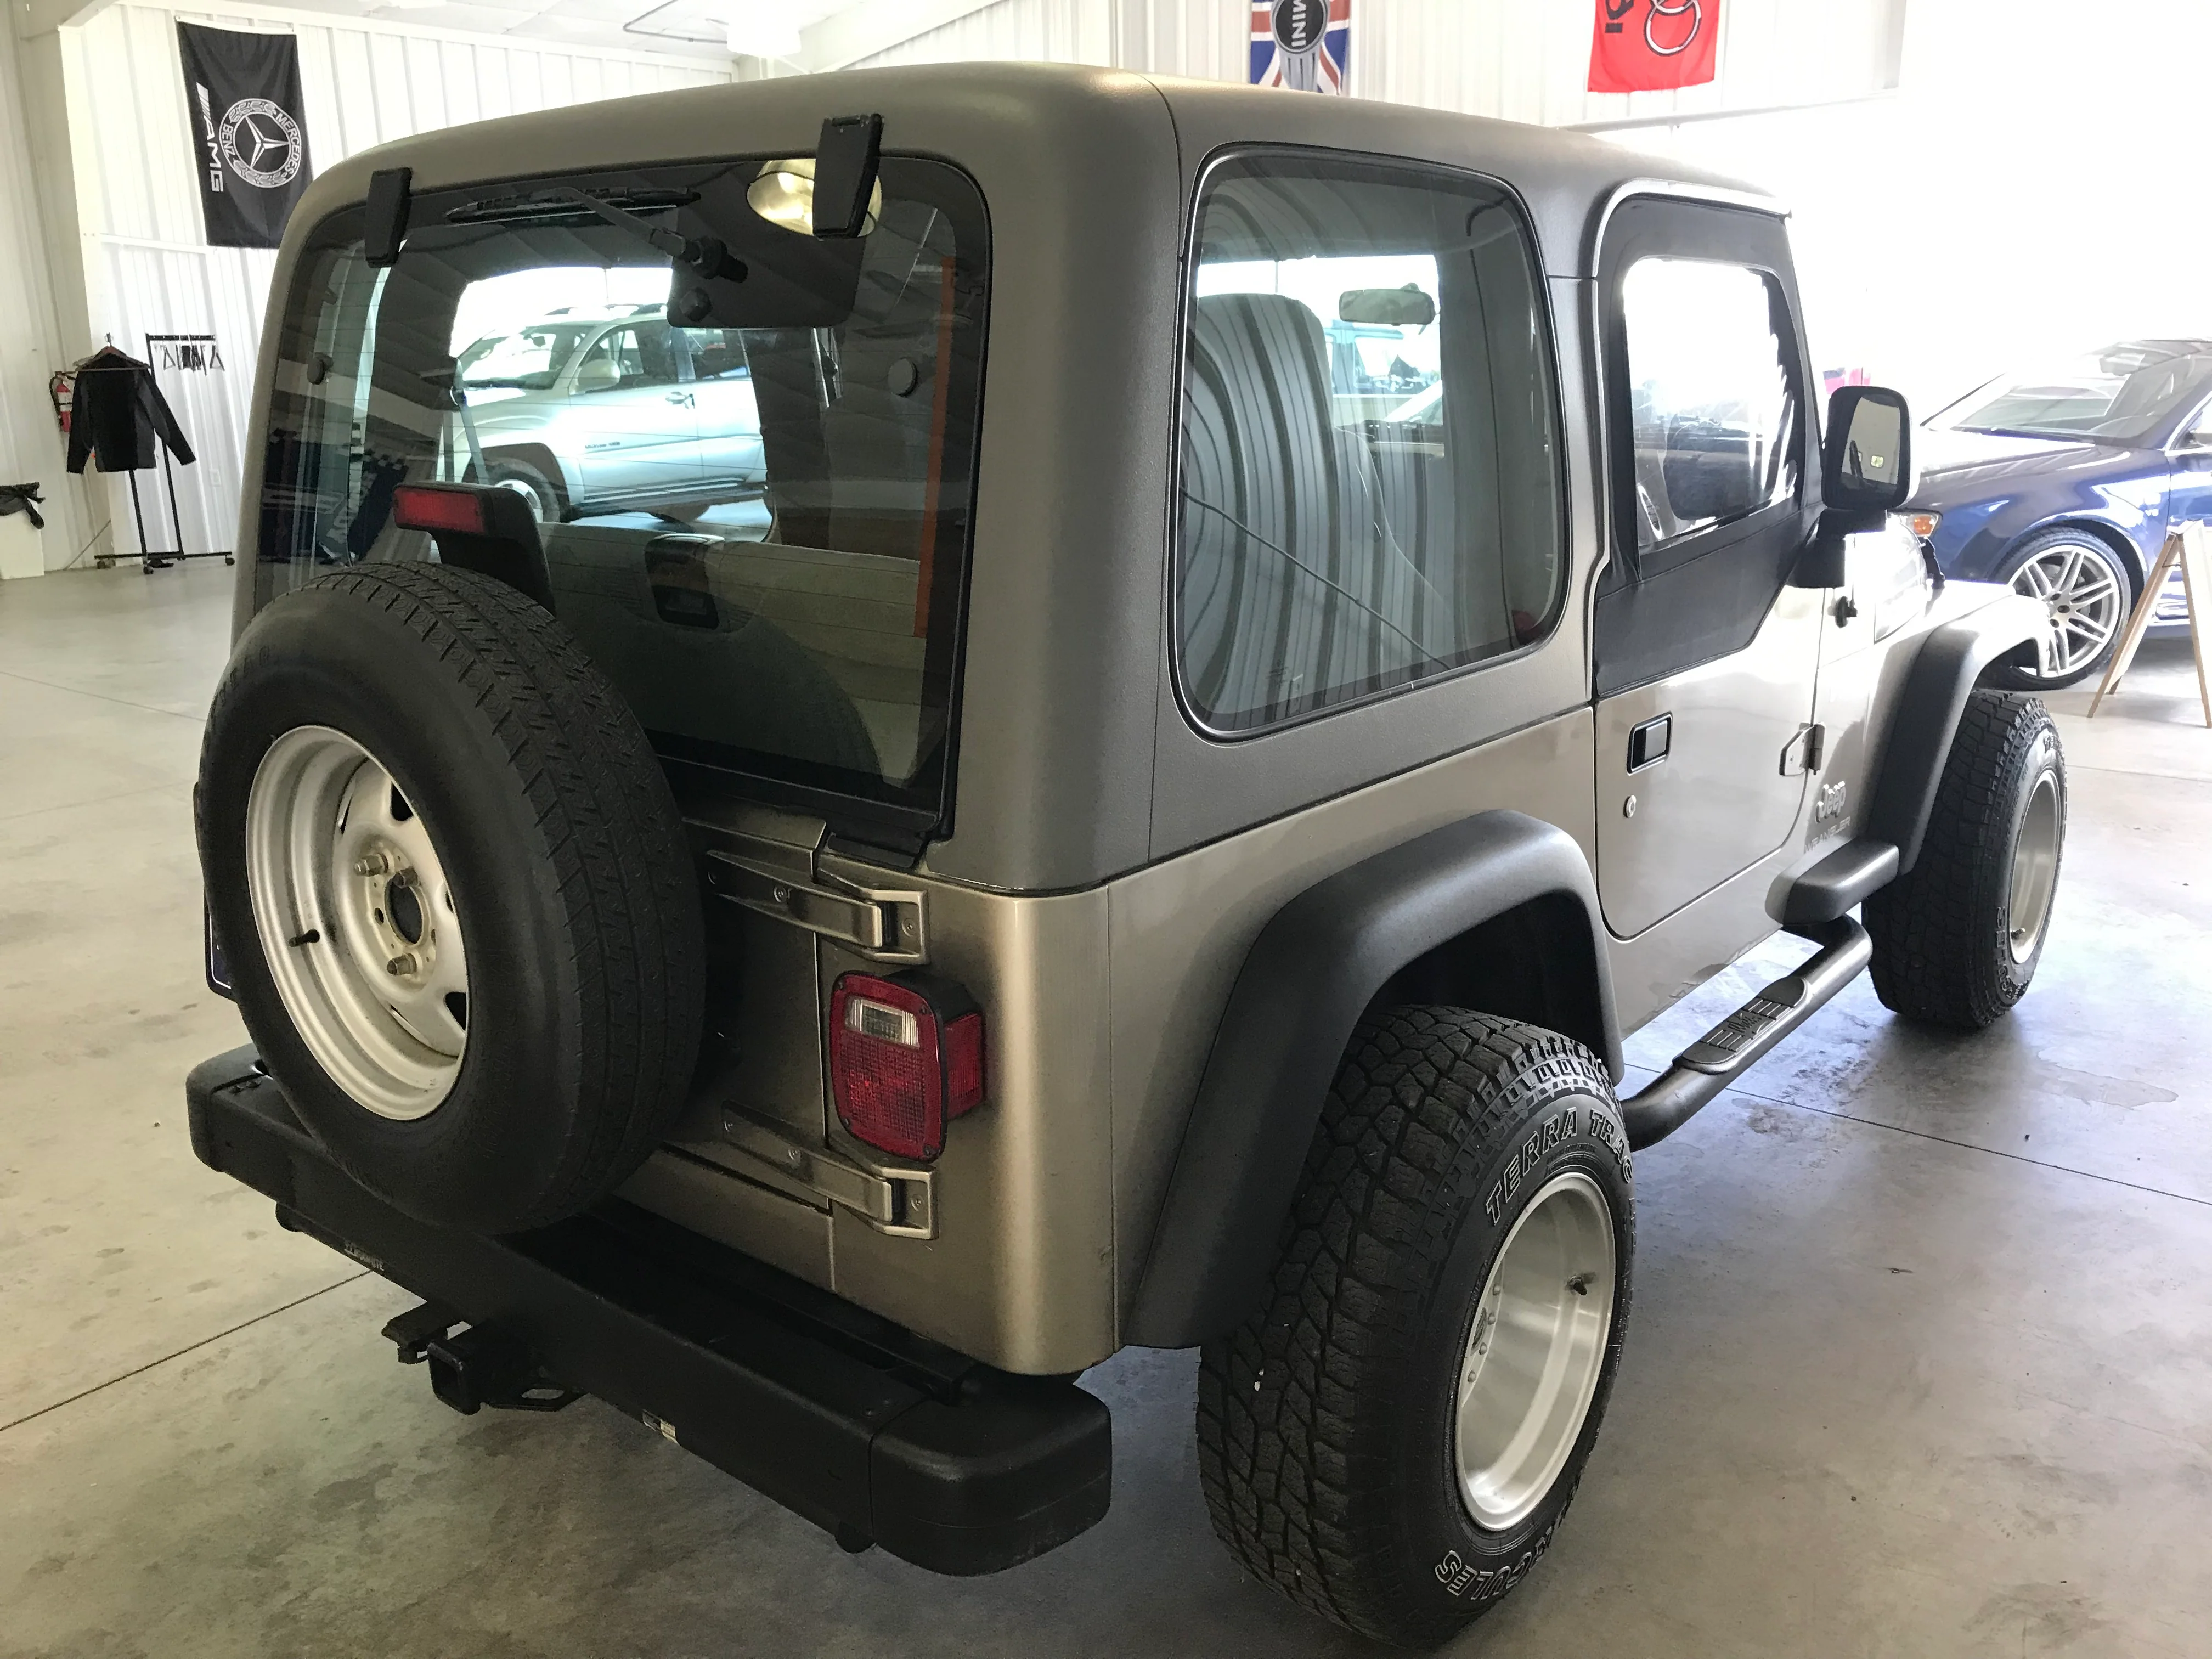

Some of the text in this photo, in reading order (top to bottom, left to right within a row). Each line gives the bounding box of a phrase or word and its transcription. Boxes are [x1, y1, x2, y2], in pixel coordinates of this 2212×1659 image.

[203, 118, 224, 193] AMG
[222, 123, 235, 158] BENZ
[275, 112, 301, 175] MERCEDES
[1815, 780, 1847, 823] Jeep
[1486, 1107, 1634, 1225] TERRA TRAC
